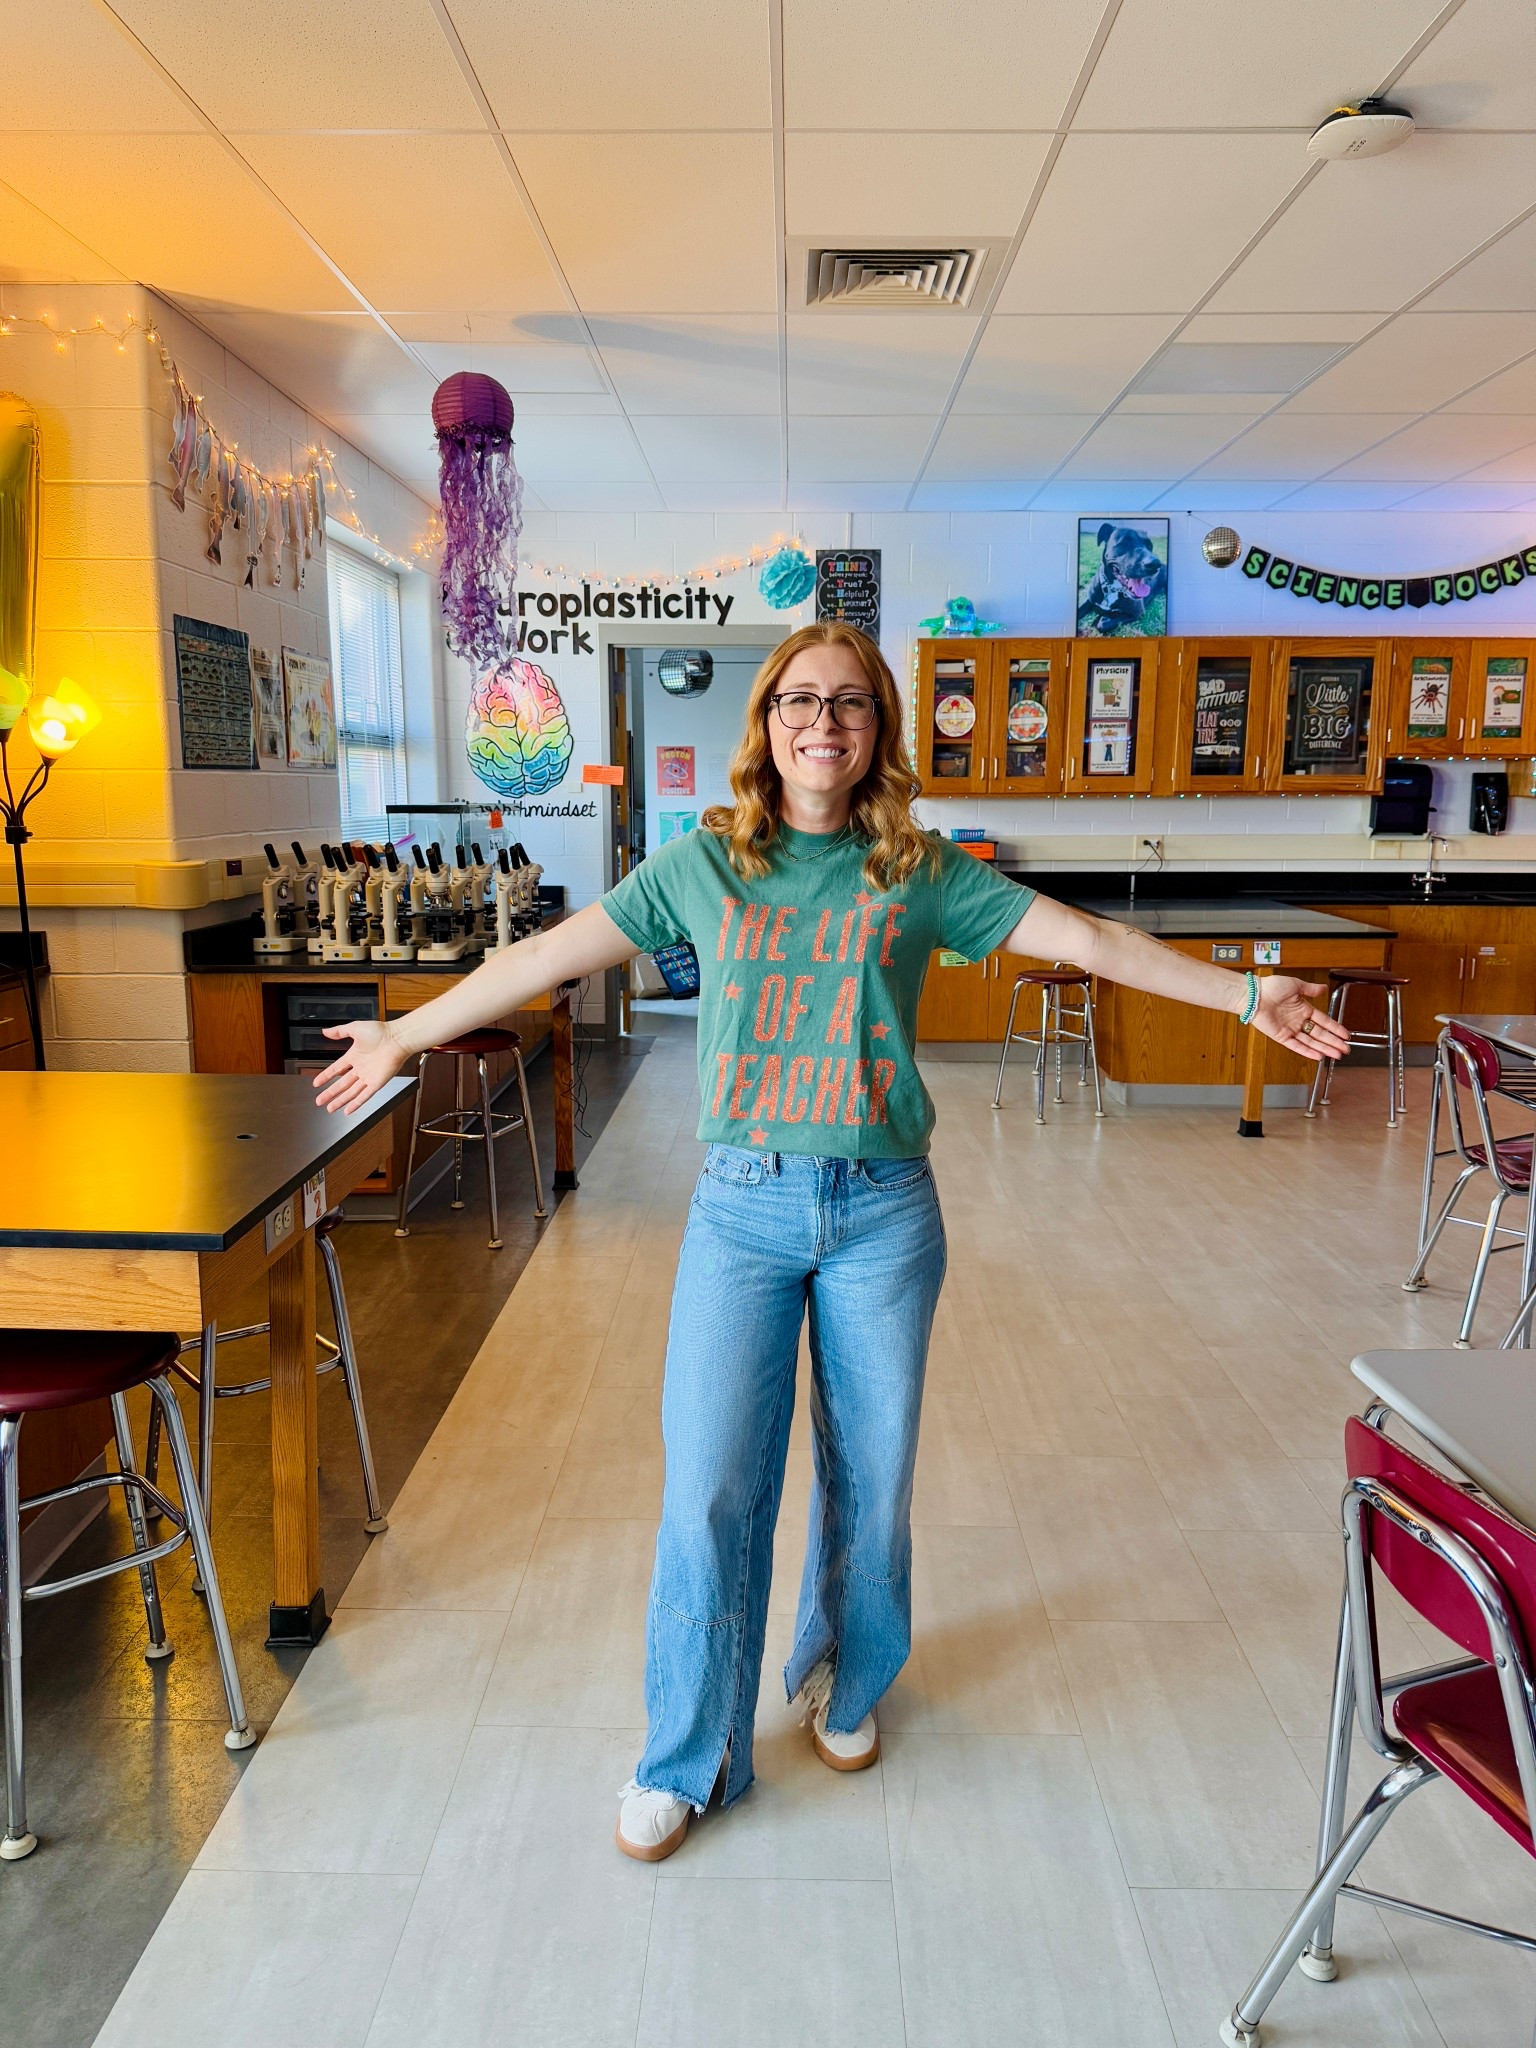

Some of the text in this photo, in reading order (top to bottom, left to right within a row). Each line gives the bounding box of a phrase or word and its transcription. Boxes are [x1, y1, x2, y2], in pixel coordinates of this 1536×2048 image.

[828, 561, 868, 572] THINK
[837, 579, 863, 588] True?
[1246, 550, 1536, 606] SCIENCE ROCKS
[837, 589, 870, 599] Helpful?
[443, 583, 734, 627] uroplasticity
[1199, 679, 1226, 696] BAD
[1306, 683, 1349, 707] Little
[1196, 689, 1246, 711] ATTITUDE
[1303, 714, 1352, 739] BIG
[1196, 728, 1218, 745] TIRE
[1308, 740, 1343, 749] DIFFERENCE
[660, 751, 691, 761] PROTON
[716, 896, 907, 966] THE LIFE
[1255, 942, 1279, 951] TABLE
[1264, 950, 1272, 962] 4
[753, 974, 858, 1044] OF A
[711, 1053, 897, 1125] TEACHER
[314, 1190, 322, 1218] 2
